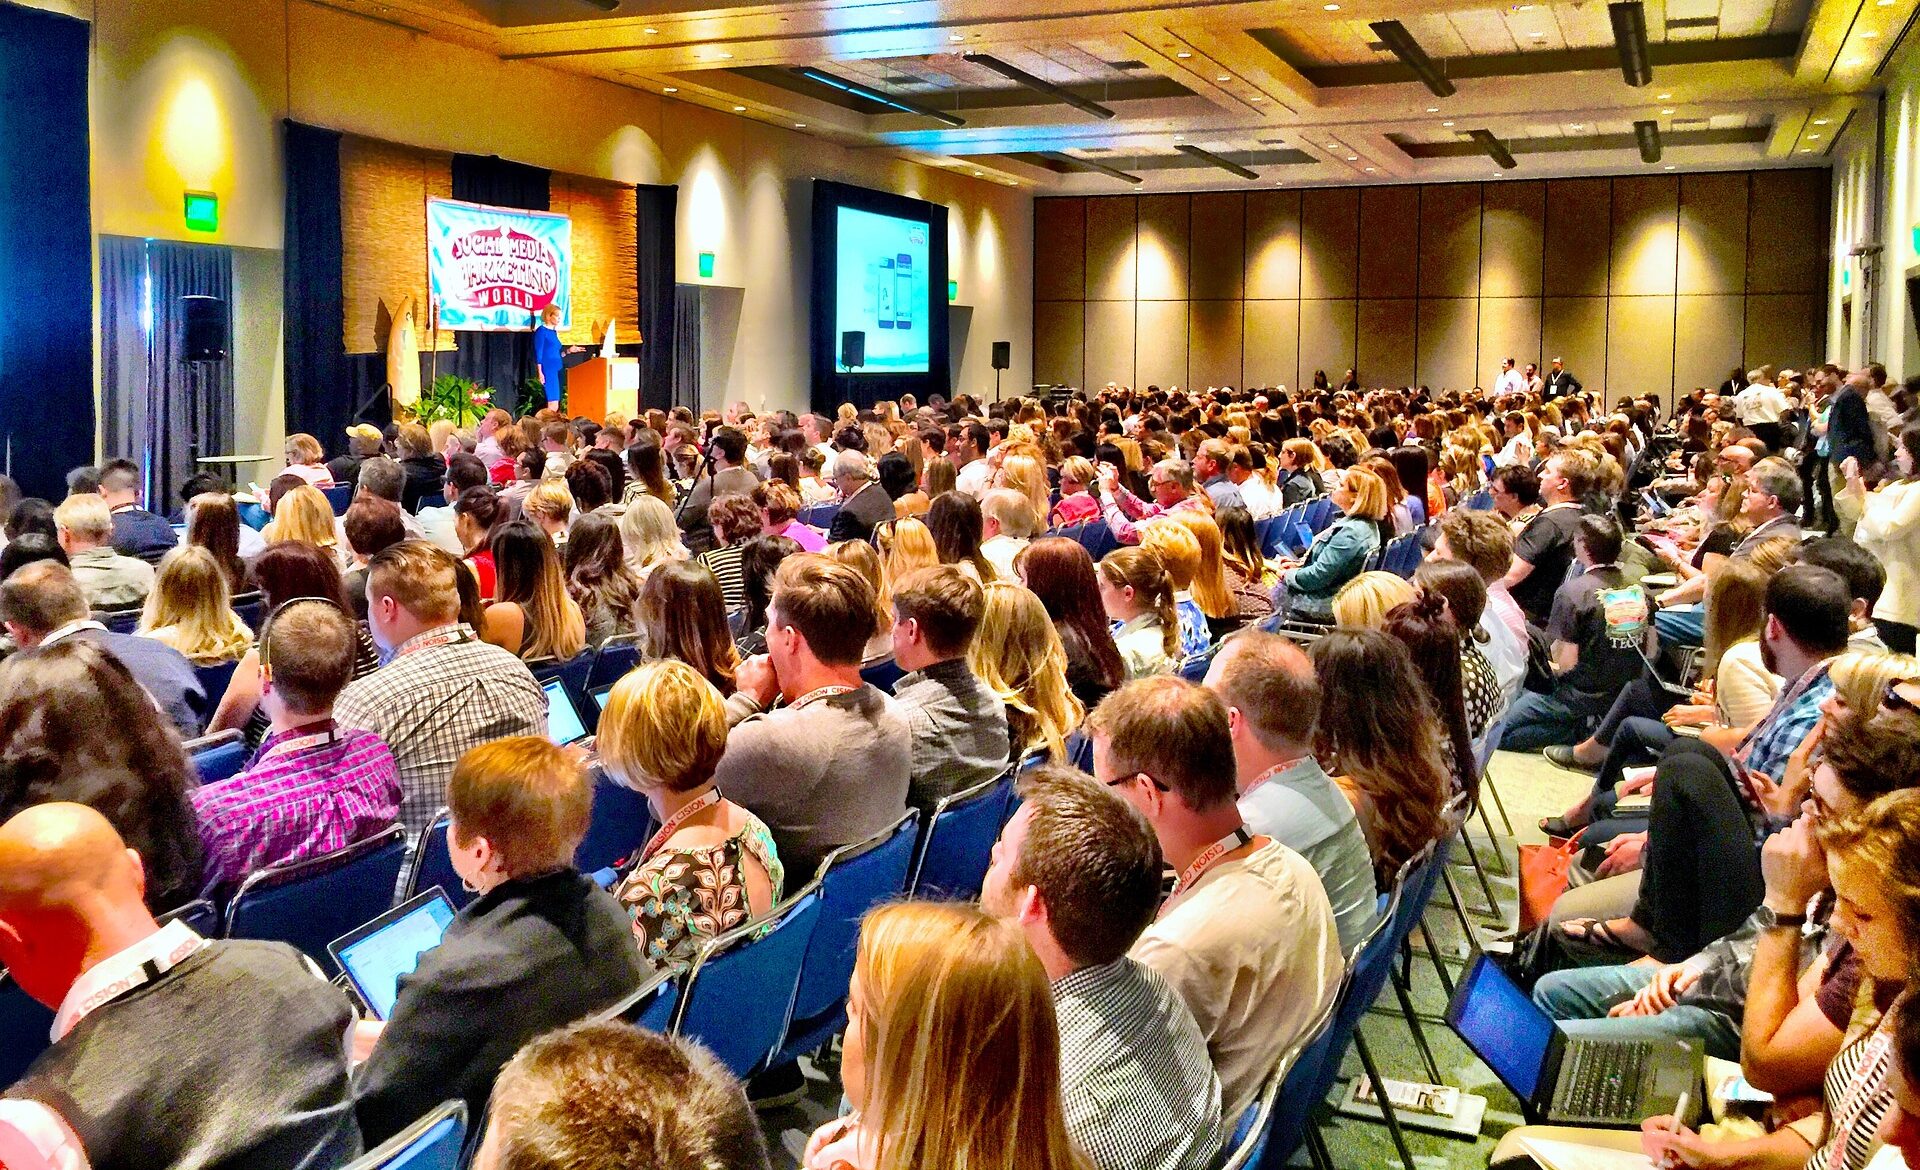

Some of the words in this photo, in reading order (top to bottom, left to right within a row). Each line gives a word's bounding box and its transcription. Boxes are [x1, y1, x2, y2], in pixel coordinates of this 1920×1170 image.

[453, 234, 504, 260] SOCIAL
[508, 236, 553, 267] MEDIA
[477, 287, 534, 309] WORLD
[676, 798, 706, 821] CISION
[1192, 843, 1225, 873] CISION
[82, 977, 131, 1012] CISION
